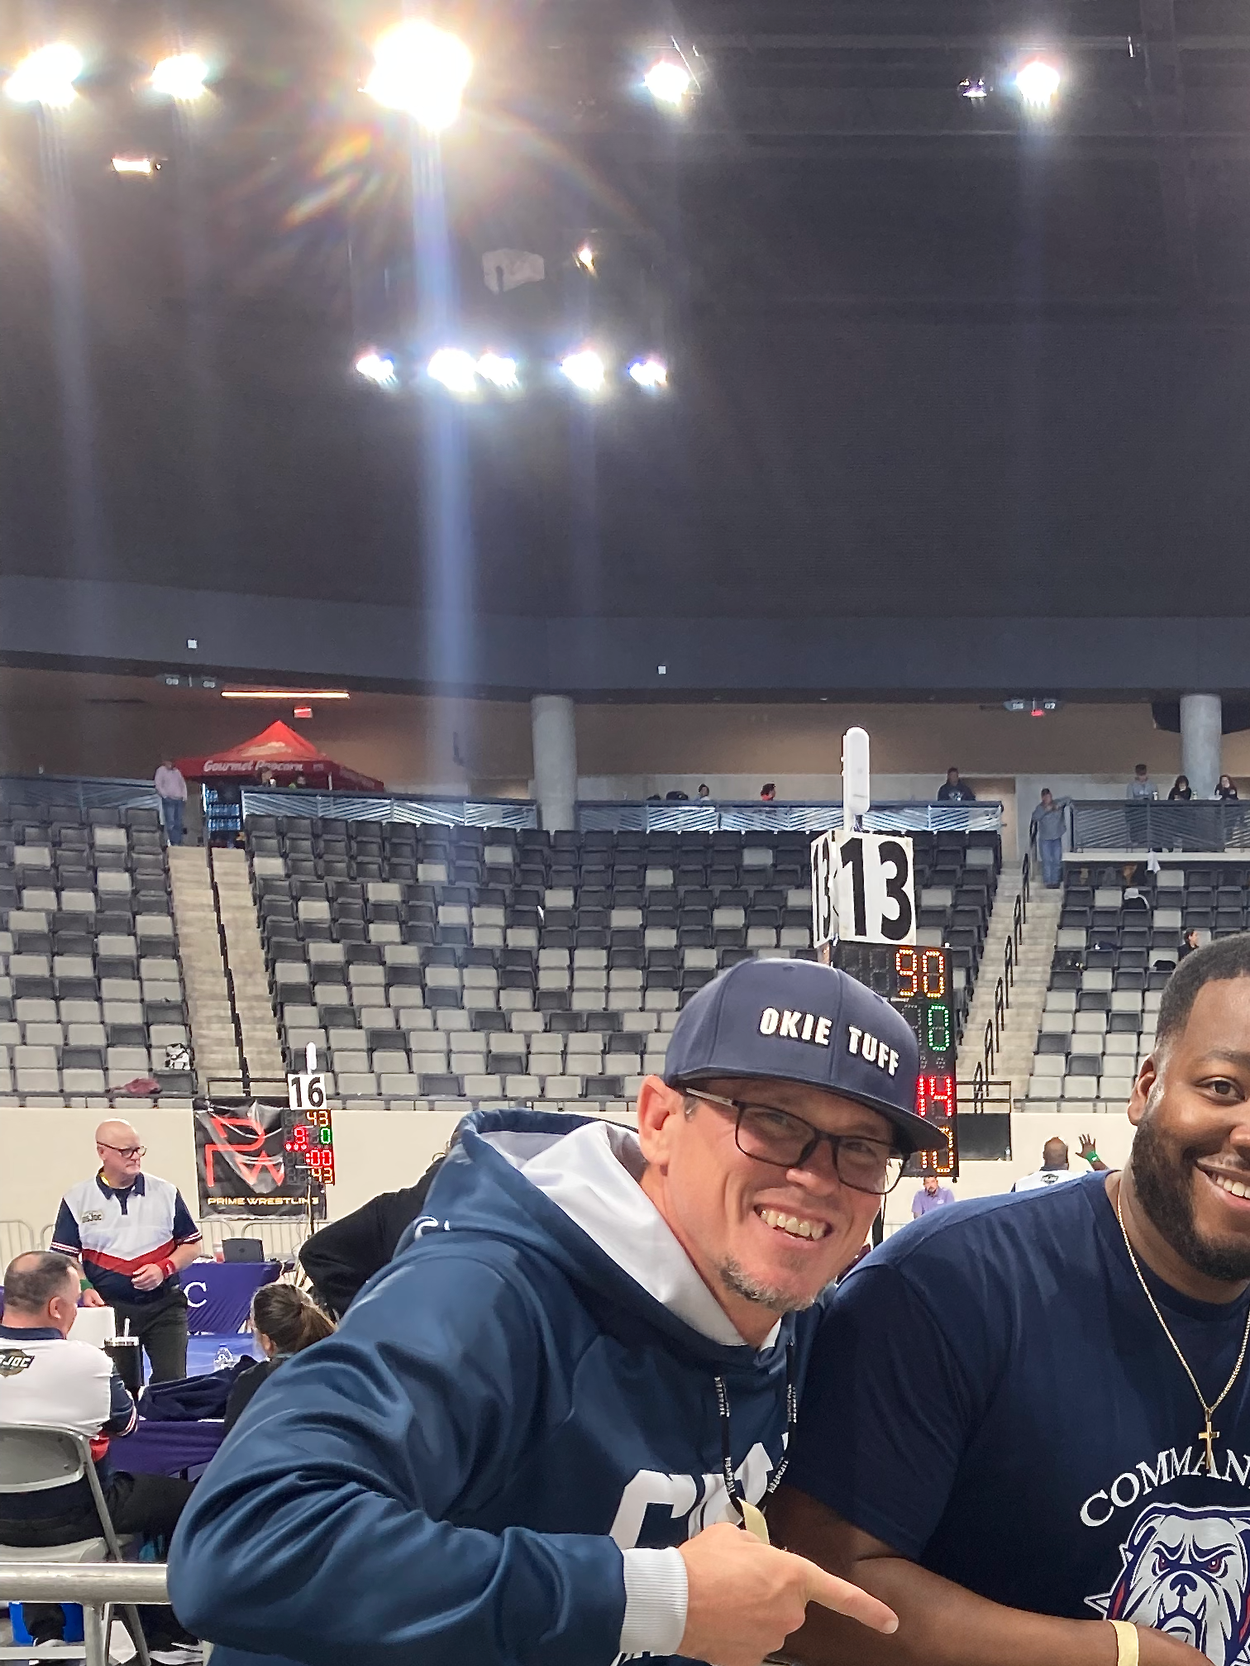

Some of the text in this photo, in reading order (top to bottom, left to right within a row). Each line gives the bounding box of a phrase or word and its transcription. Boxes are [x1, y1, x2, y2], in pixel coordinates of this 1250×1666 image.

[203, 760, 253, 773] Gourmet
[839, 836, 913, 941] 13
[895, 948, 945, 999] 90
[759, 1007, 900, 1077] OKIE TUFF
[291, 1076, 325, 1108] 16
[207, 1197, 246, 1206] PRIME
[184, 1281, 208, 1308] C
